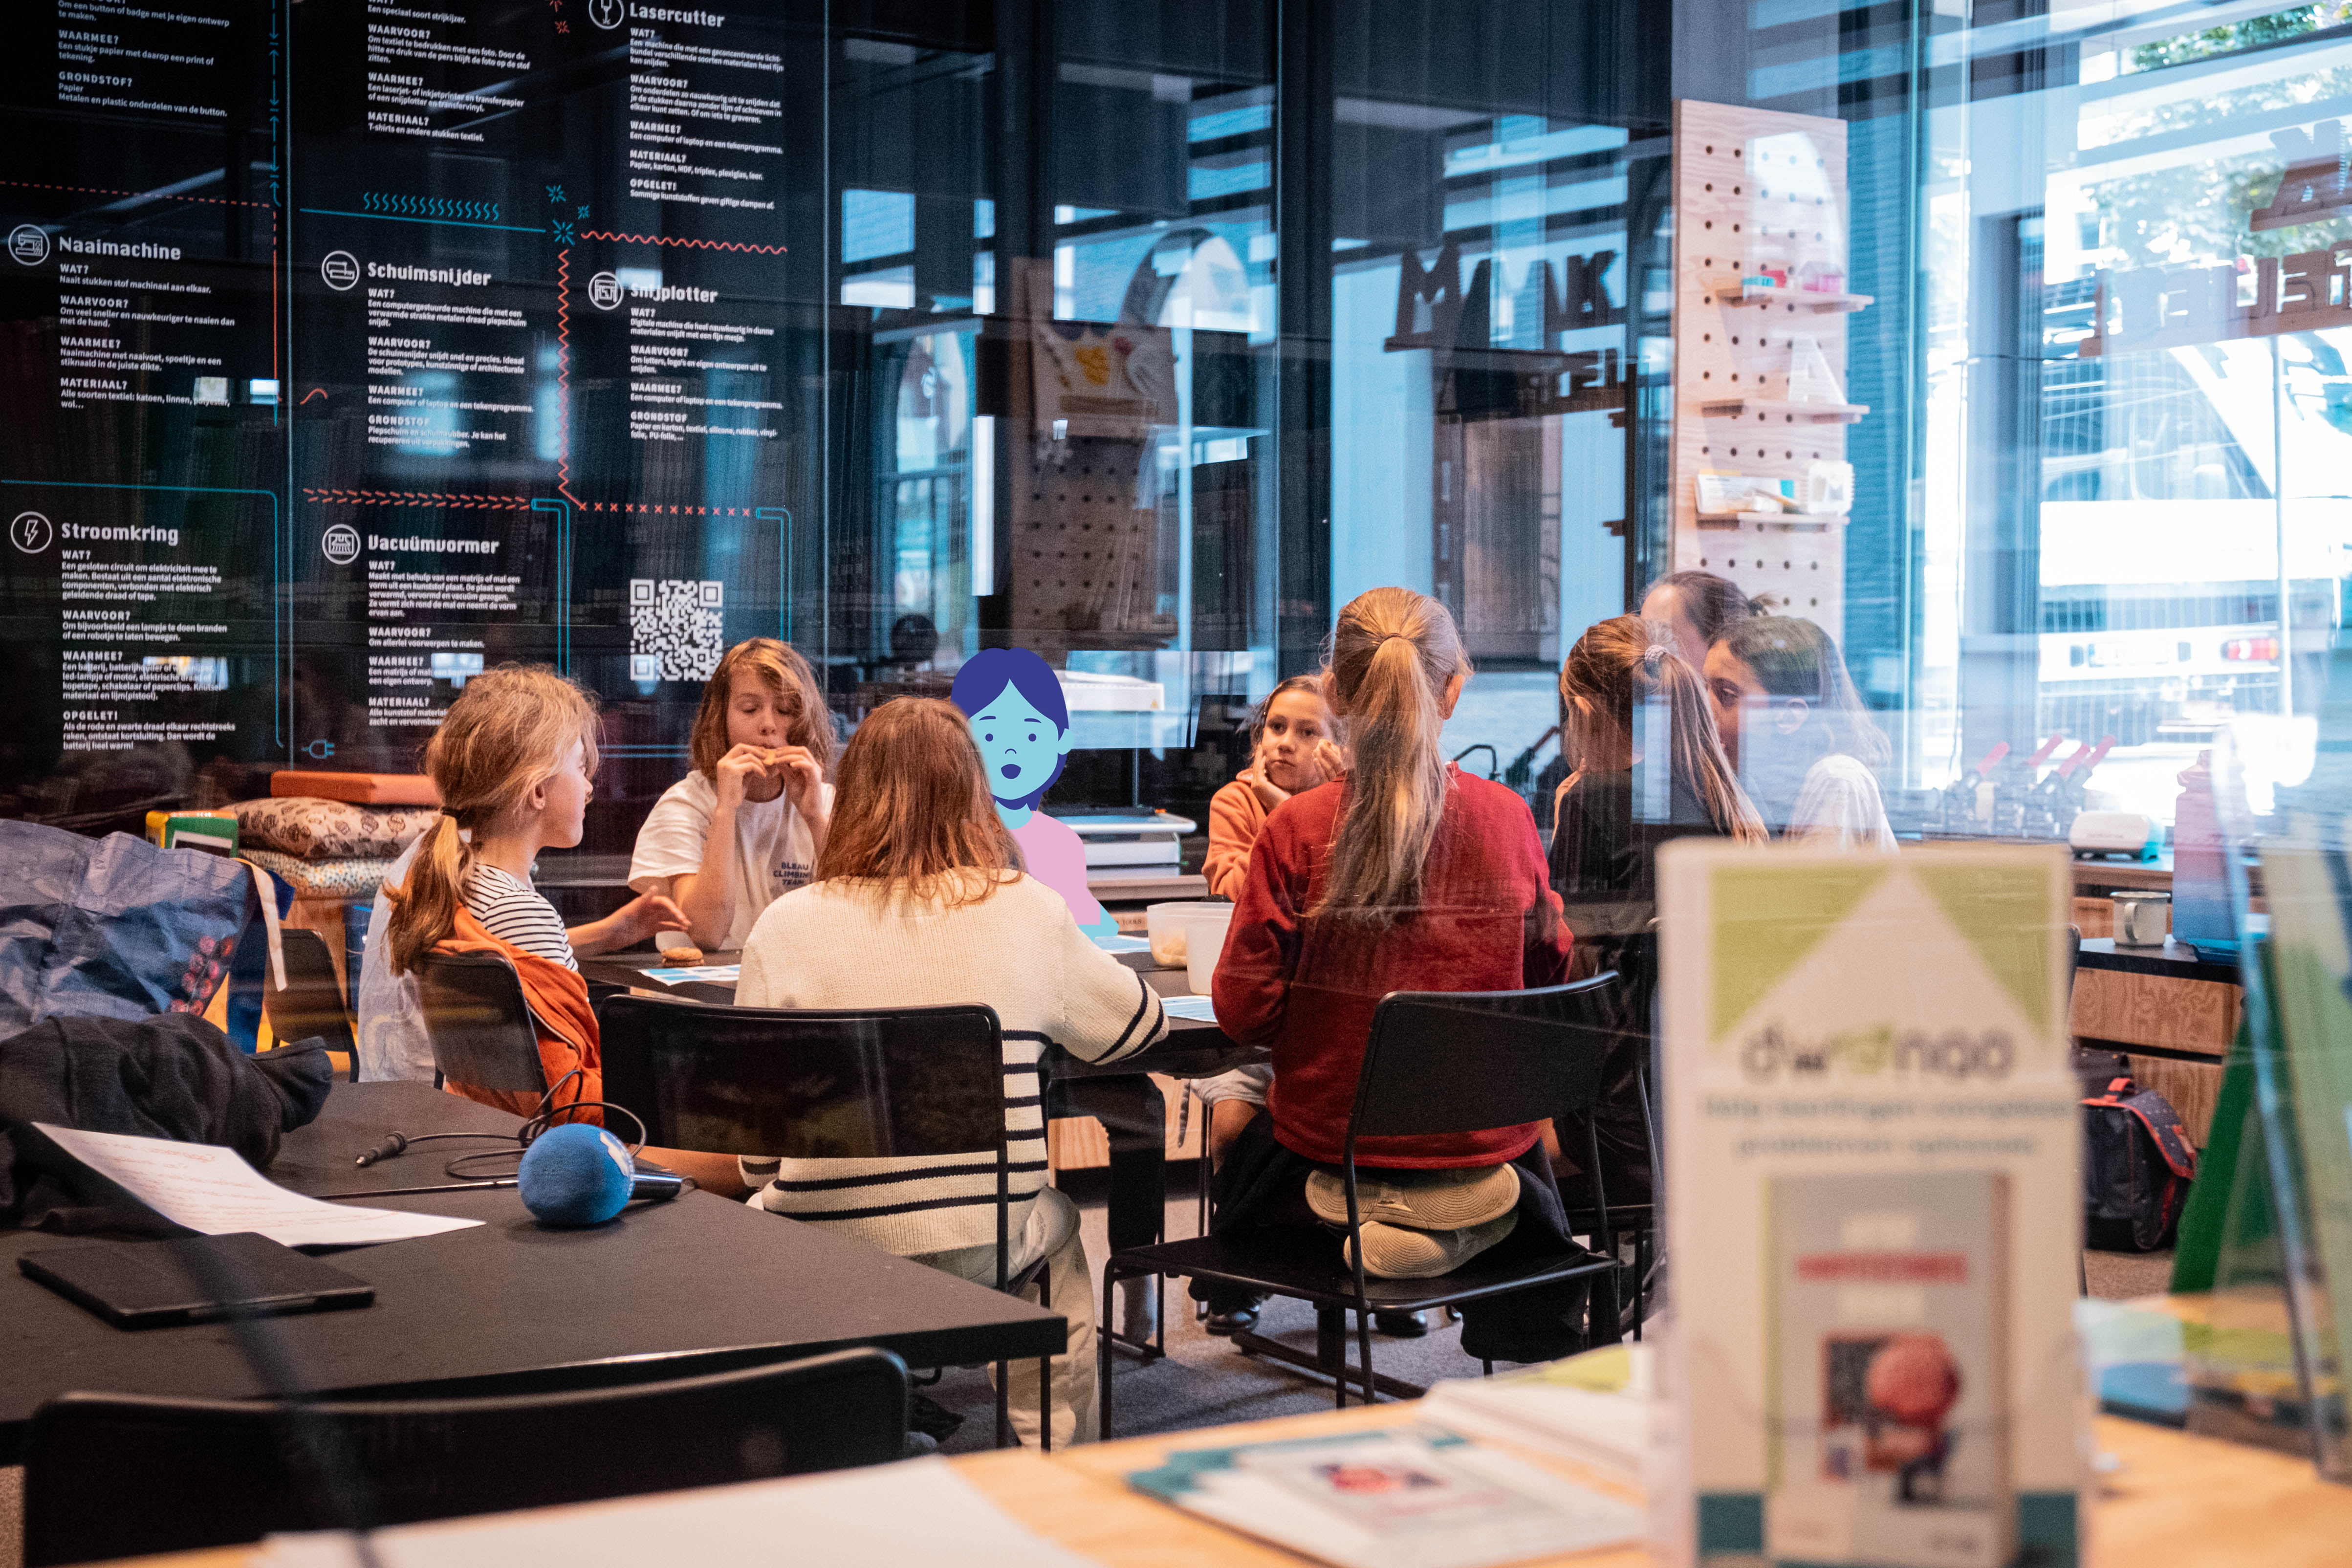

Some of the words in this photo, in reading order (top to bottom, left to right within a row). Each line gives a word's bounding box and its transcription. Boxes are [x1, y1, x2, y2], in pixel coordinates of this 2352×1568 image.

[630, 2, 725, 27] Lasercutter
[58, 29, 119, 44] WAARMEE?
[368, 23, 431, 39] WAARVOOR?
[630, 27, 655, 37] WAT?
[58, 70, 132, 87] GRONDSTOF?
[368, 72, 424, 86] WAARMEE?
[630, 74, 689, 88] WAARVOOR?
[368, 111, 429, 126] MATERIAAL?
[630, 120, 682, 134] WAARMEE?
[630, 149, 687, 163] MATERIAAL?
[630, 178, 677, 191] OPGELET!
[59, 236, 181, 260] Naaimachine
[60, 263, 89, 274] WAT?
[368, 262, 492, 286] Schuimsnijder
[60, 275, 80, 284] Naait
[82, 277, 112, 286] stukken
[113, 279, 128, 287] stof
[130, 281, 169, 290] machinaal
[368, 288, 395, 298] WAT?
[60, 295, 129, 308] WAARVOOR?
[60, 306, 74, 315] Om
[93, 309, 119, 318] sneller
[131, 312, 183, 324] nauwkeuriger
[194, 316, 218, 325] naaien
[220, 317, 236, 326] dan
[630, 307, 656, 317] WAT?
[76, 317, 86, 326] de
[60, 336, 121, 348] WAARMEE?
[368, 336, 431, 349] WAARVOOR?
[60, 348, 110, 358] Naaimachine
[165, 355, 195, 365] spoeltje
[630, 345, 689, 357] WAARVOOR?
[60, 358, 96, 367] stiknaald
[97, 359, 105, 368] in
[107, 360, 116, 368] de
[117, 360, 138, 370] juiste
[60, 377, 128, 390] MATERIAAL?
[630, 382, 682, 393] WAARMEE?
[368, 385, 423, 396] WAARMEE?
[630, 411, 688, 422] GRONDSTOF
[61, 523, 178, 545] Stroomkring
[368, 535, 500, 554] Vacuümvormer
[62, 550, 91, 560] WAT?
[368, 561, 395, 570] WAT?
[62, 610, 131, 620] WAARVOOR?
[368, 628, 431, 637] WAARVOOR?
[62, 652, 123, 661] WAARMEE?
[368, 656, 424, 666] WAARMEE?
[368, 697, 429, 706] MATERIAAL?
[63, 711, 118, 720] OPGELET!
[781, 862, 809, 870] BLEAU
